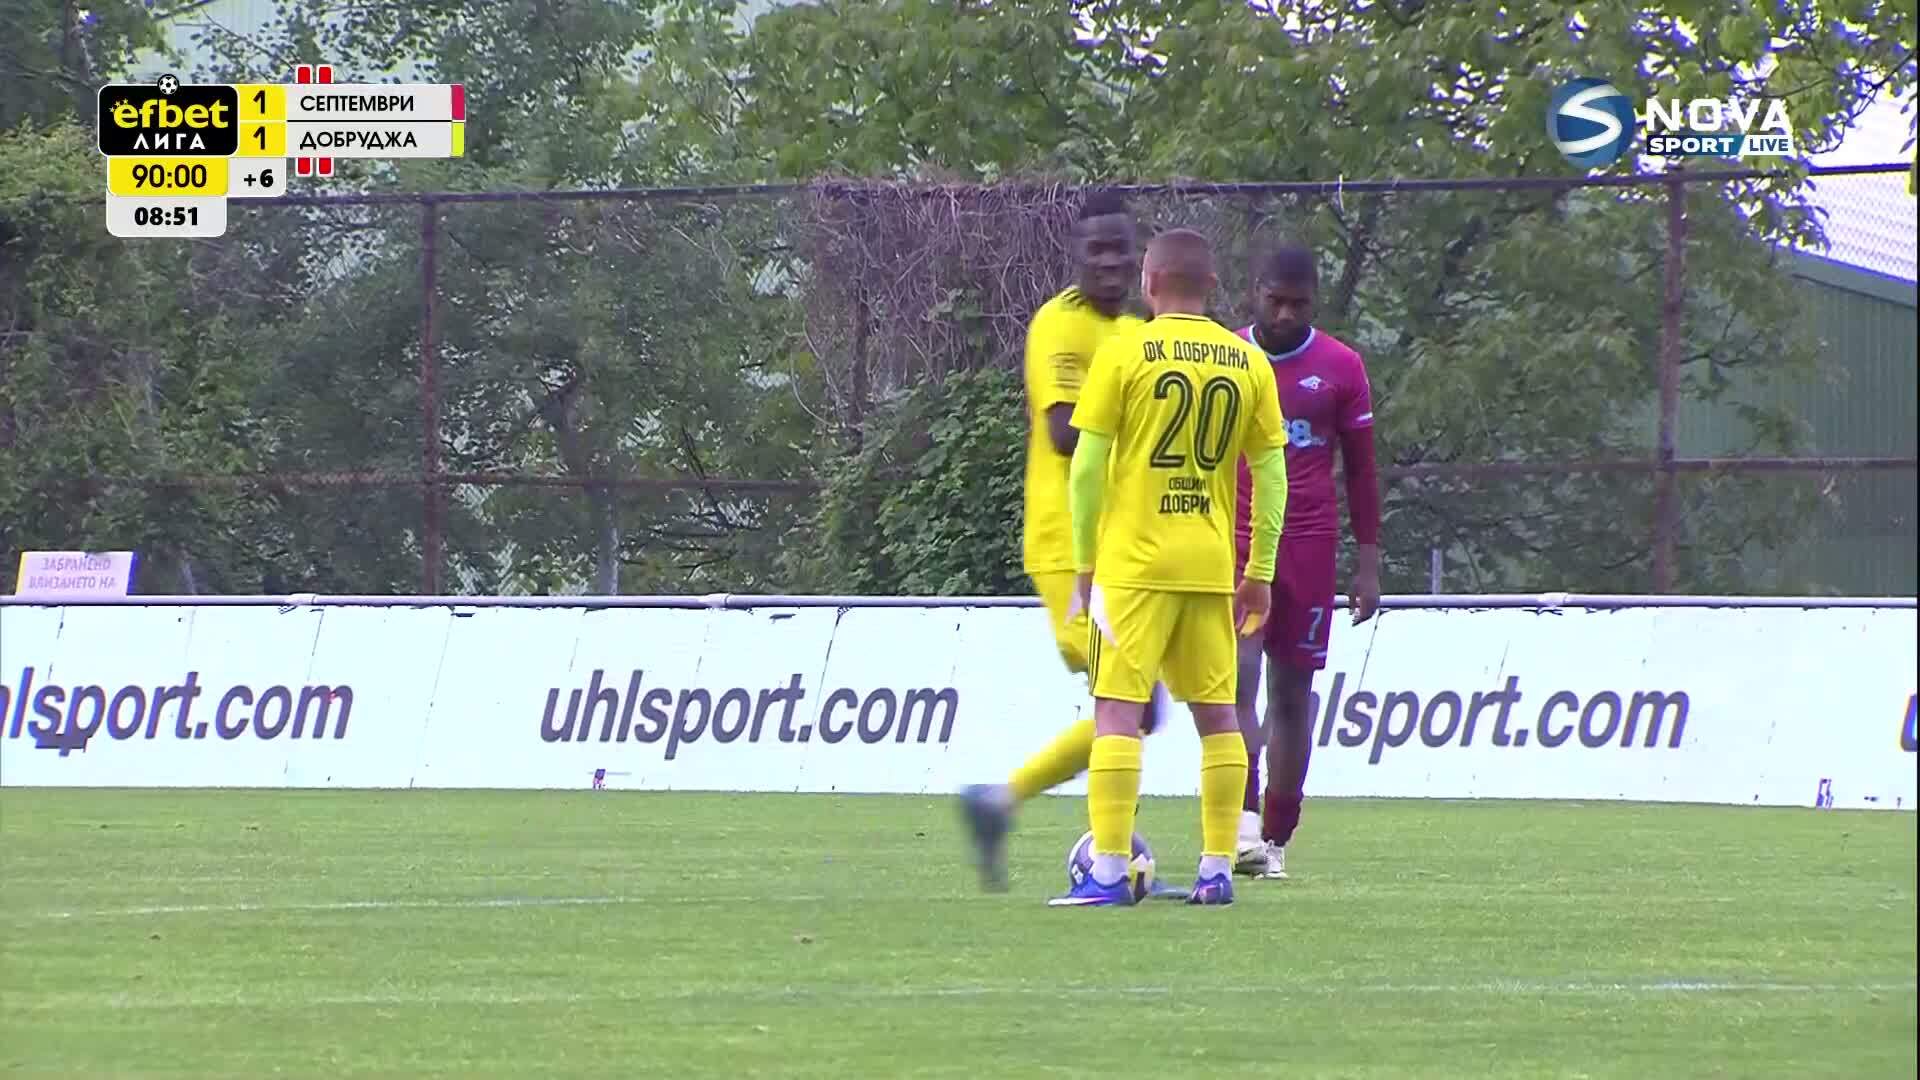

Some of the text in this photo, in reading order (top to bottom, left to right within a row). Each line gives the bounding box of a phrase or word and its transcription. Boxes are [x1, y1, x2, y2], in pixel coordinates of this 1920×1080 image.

[1143, 340, 1249, 371] ФК ДОБРУДЖА
[1150, 370, 1242, 472] 20
[1308, 607, 1324, 641] 7
[541, 669, 958, 760] uhlsport.com
